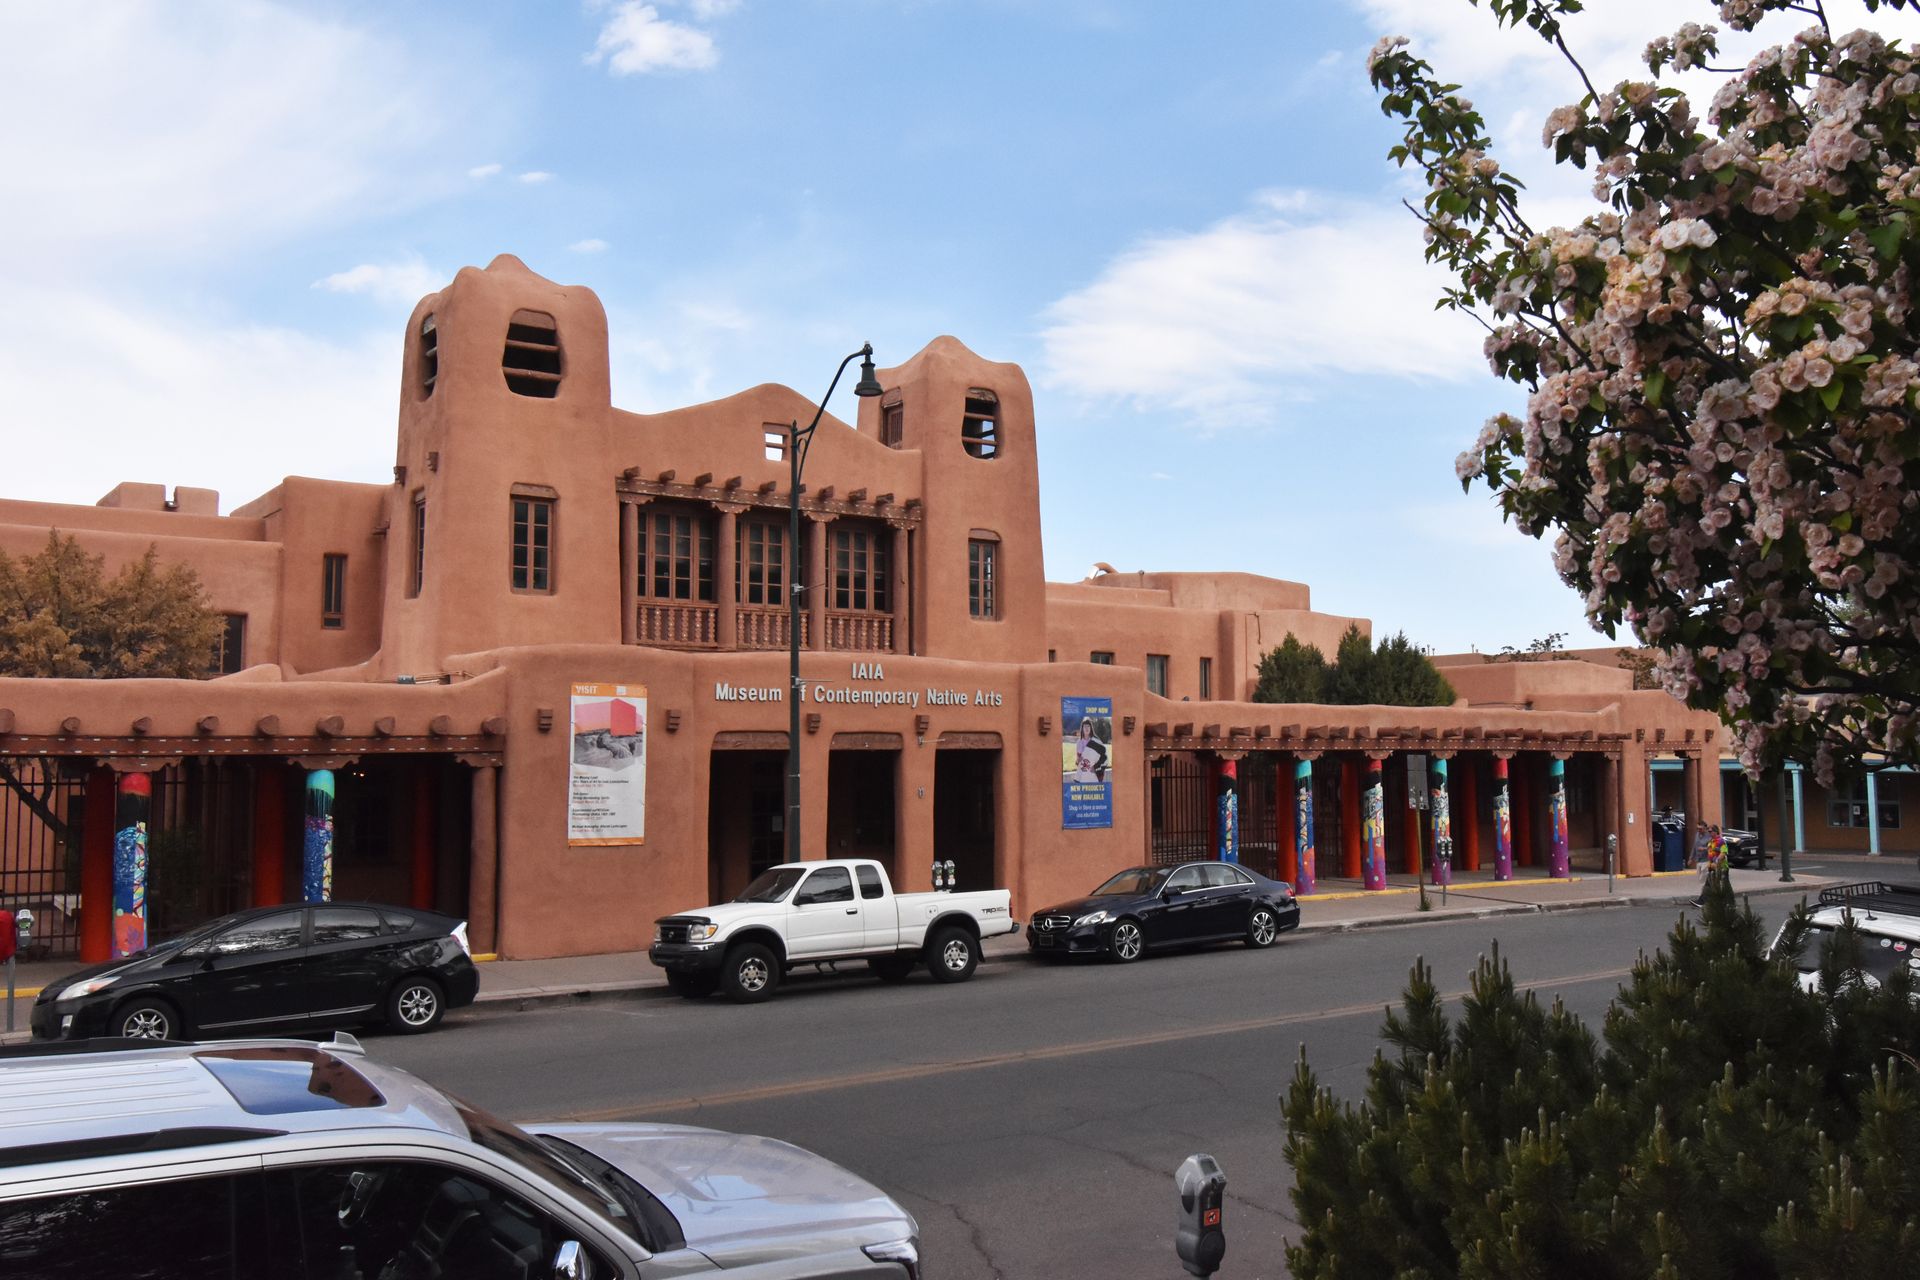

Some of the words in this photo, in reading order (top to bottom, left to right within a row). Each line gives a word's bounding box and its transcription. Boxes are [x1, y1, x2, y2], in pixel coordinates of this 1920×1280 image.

[852, 662, 884, 680] IAIA
[575, 685, 598, 695] VISIT
[715, 682, 782, 701] Museum
[814, 685, 919, 709] Contemporary
[926, 688, 968, 706] Native
[975, 689, 1002, 706] Arts
[1085, 706, 1097, 714] SHOP
[1098, 706, 1109, 714] NOW
